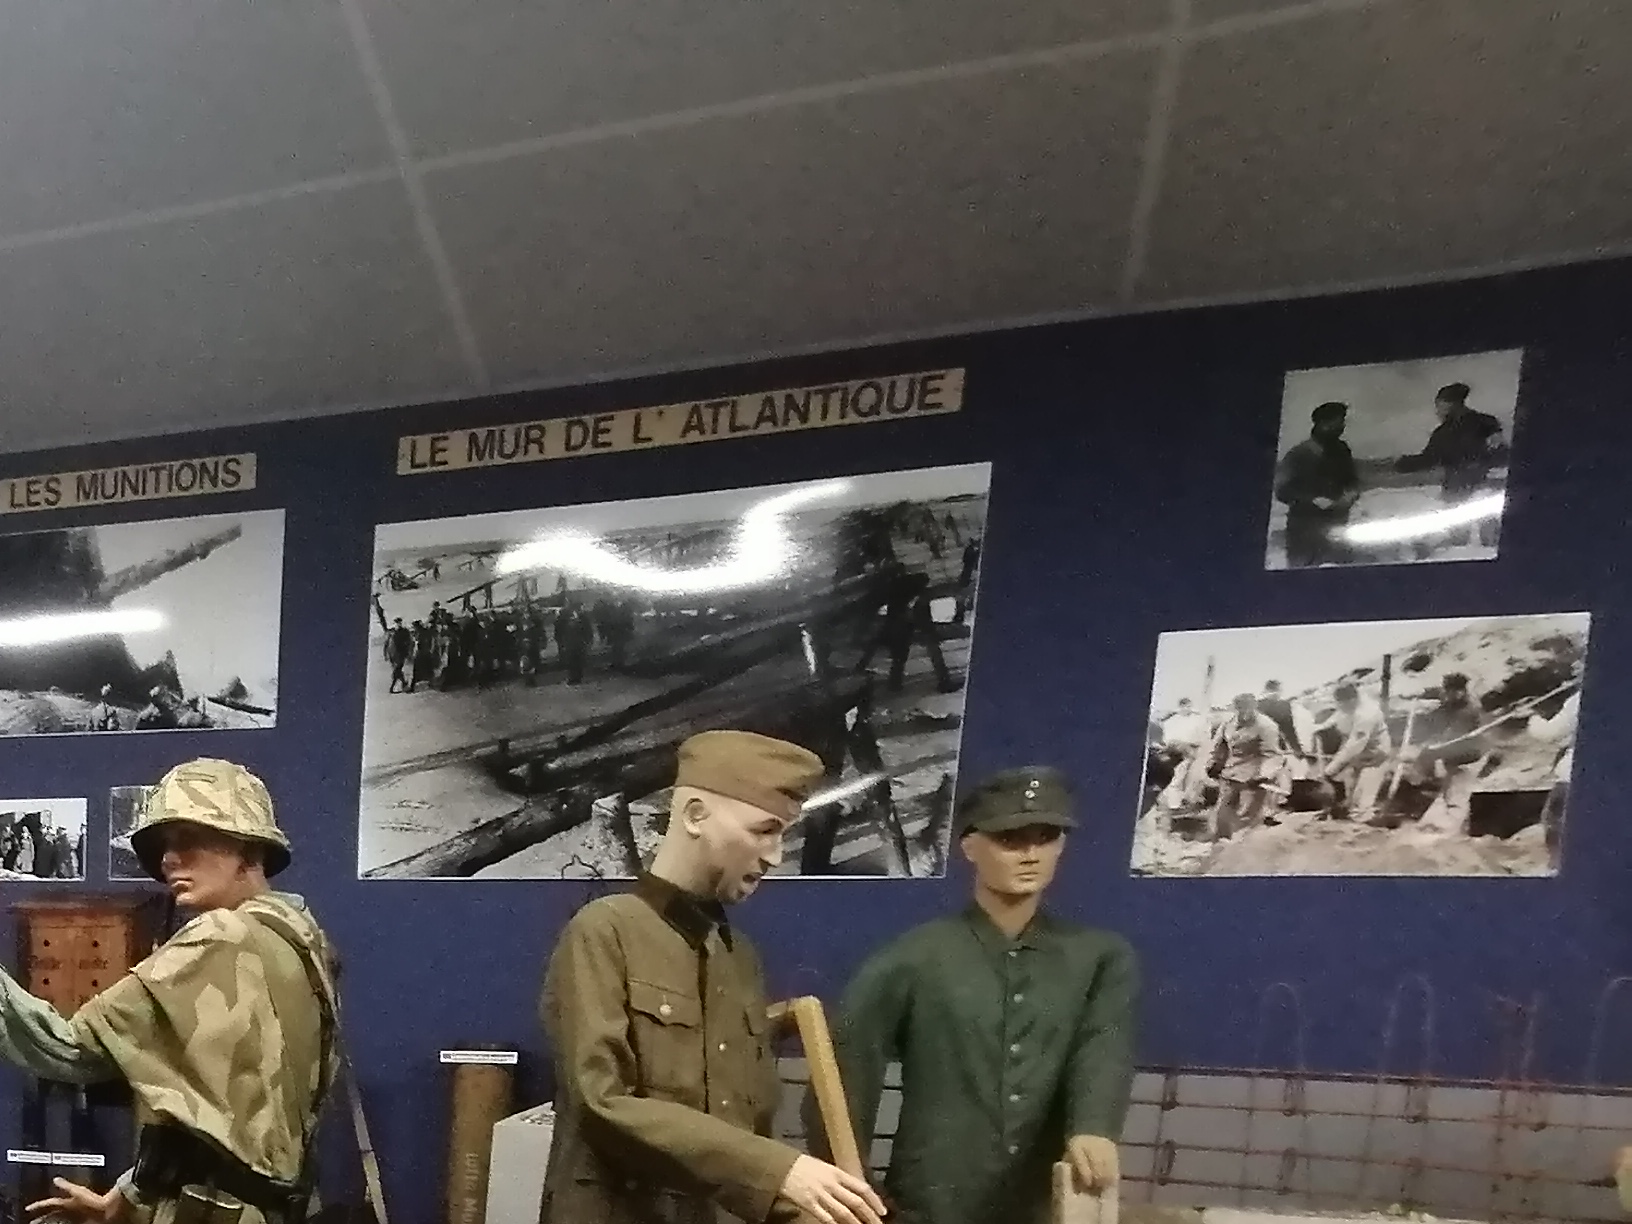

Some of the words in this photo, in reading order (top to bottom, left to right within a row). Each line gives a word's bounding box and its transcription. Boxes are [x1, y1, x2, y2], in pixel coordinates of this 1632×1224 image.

[408, 435, 449, 470] LE
[468, 424, 545, 463] MUR
[564, 415, 615, 452] DE
[679, 373, 946, 439] ATLANTIQUE
[9, 477, 63, 510] LES
[76, 457, 242, 502] MUNITIONS
